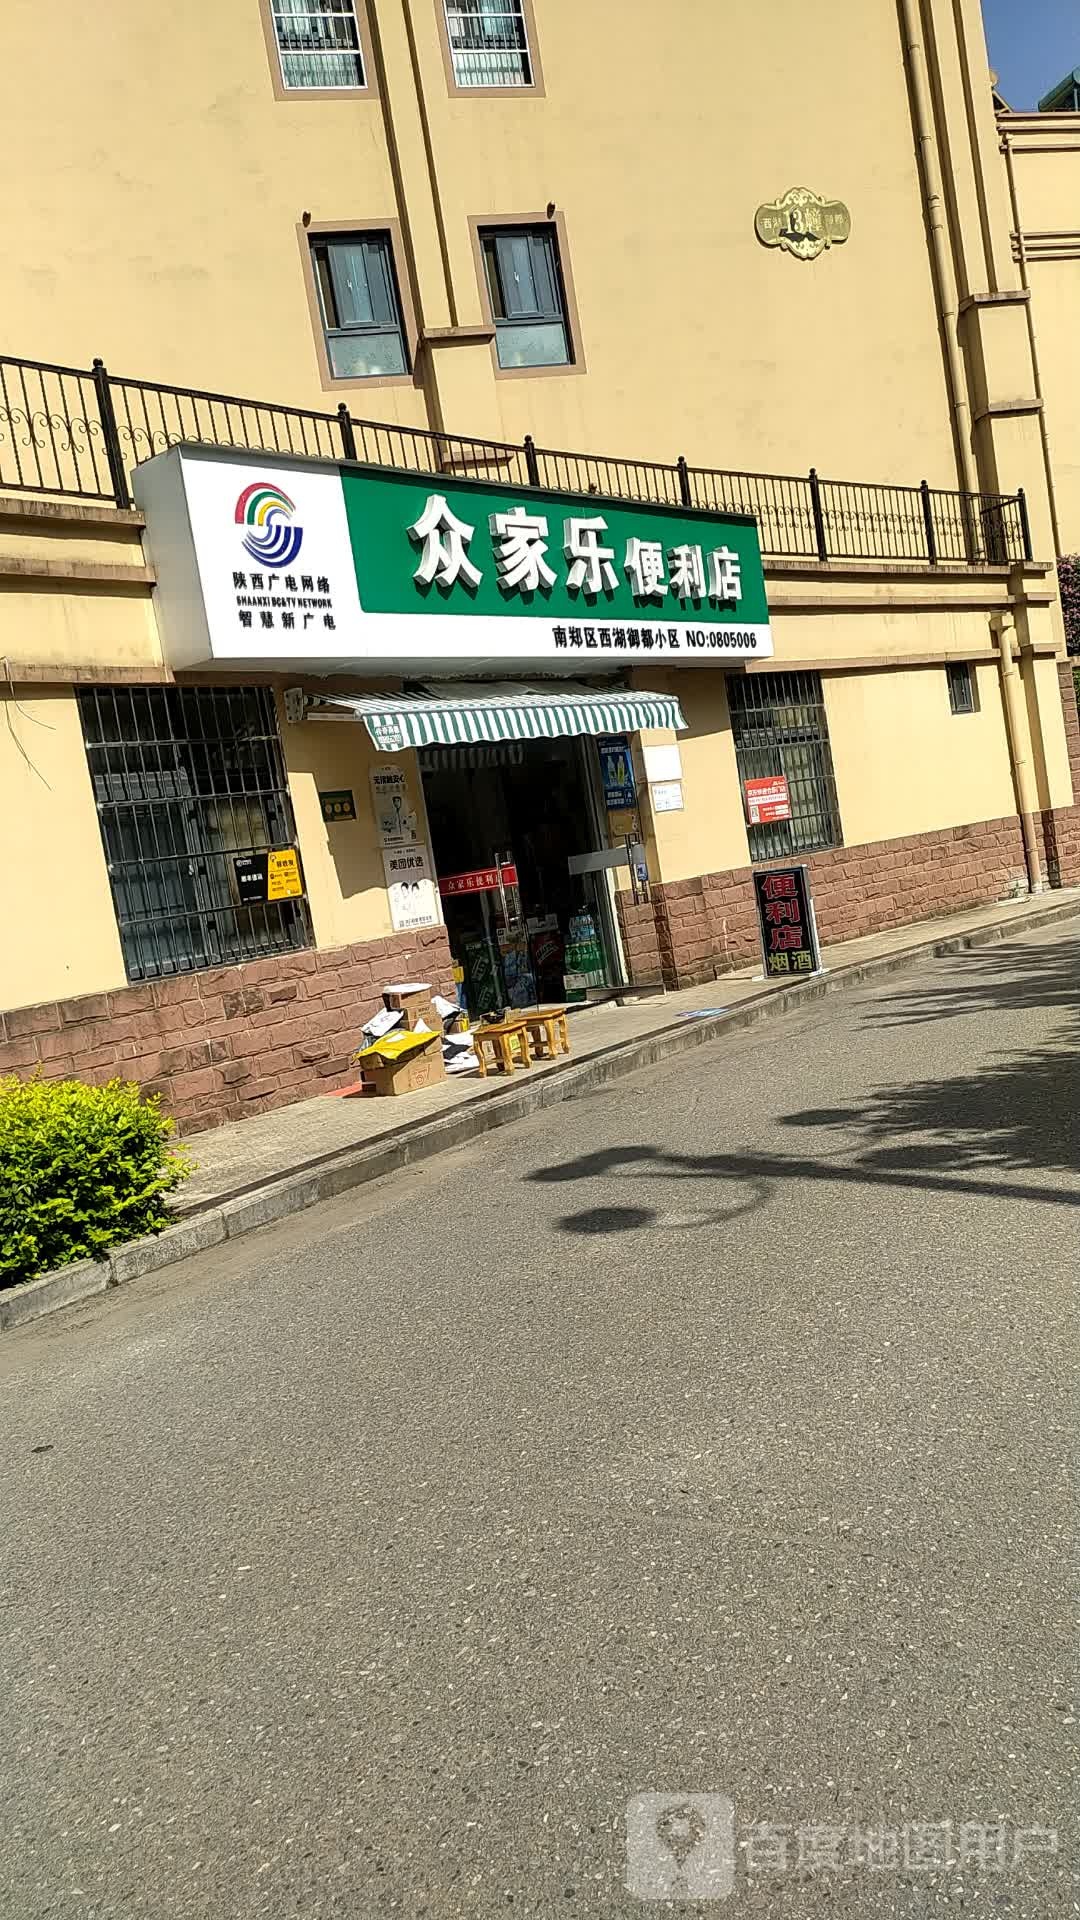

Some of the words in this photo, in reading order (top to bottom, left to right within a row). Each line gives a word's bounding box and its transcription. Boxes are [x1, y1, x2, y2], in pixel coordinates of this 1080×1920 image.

[406, 494, 743, 601] 众家乐便利店
[232, 571, 330, 594] 陕西广电网络
[236, 595, 270, 607] SHAANXI
[271, 596, 296, 608] BC&TV
[297, 597, 333, 609] NETWORK
[238, 609, 336, 631] 智慧新广电
[552, 625, 681, 649] 南郑区西湖御都小区
[686, 630, 757, 649] NO:0805006
[389, 856, 424, 871] 美团优选
[761, 873, 804, 950] 便利店
[768, 951, 814, 971] 烟酒
